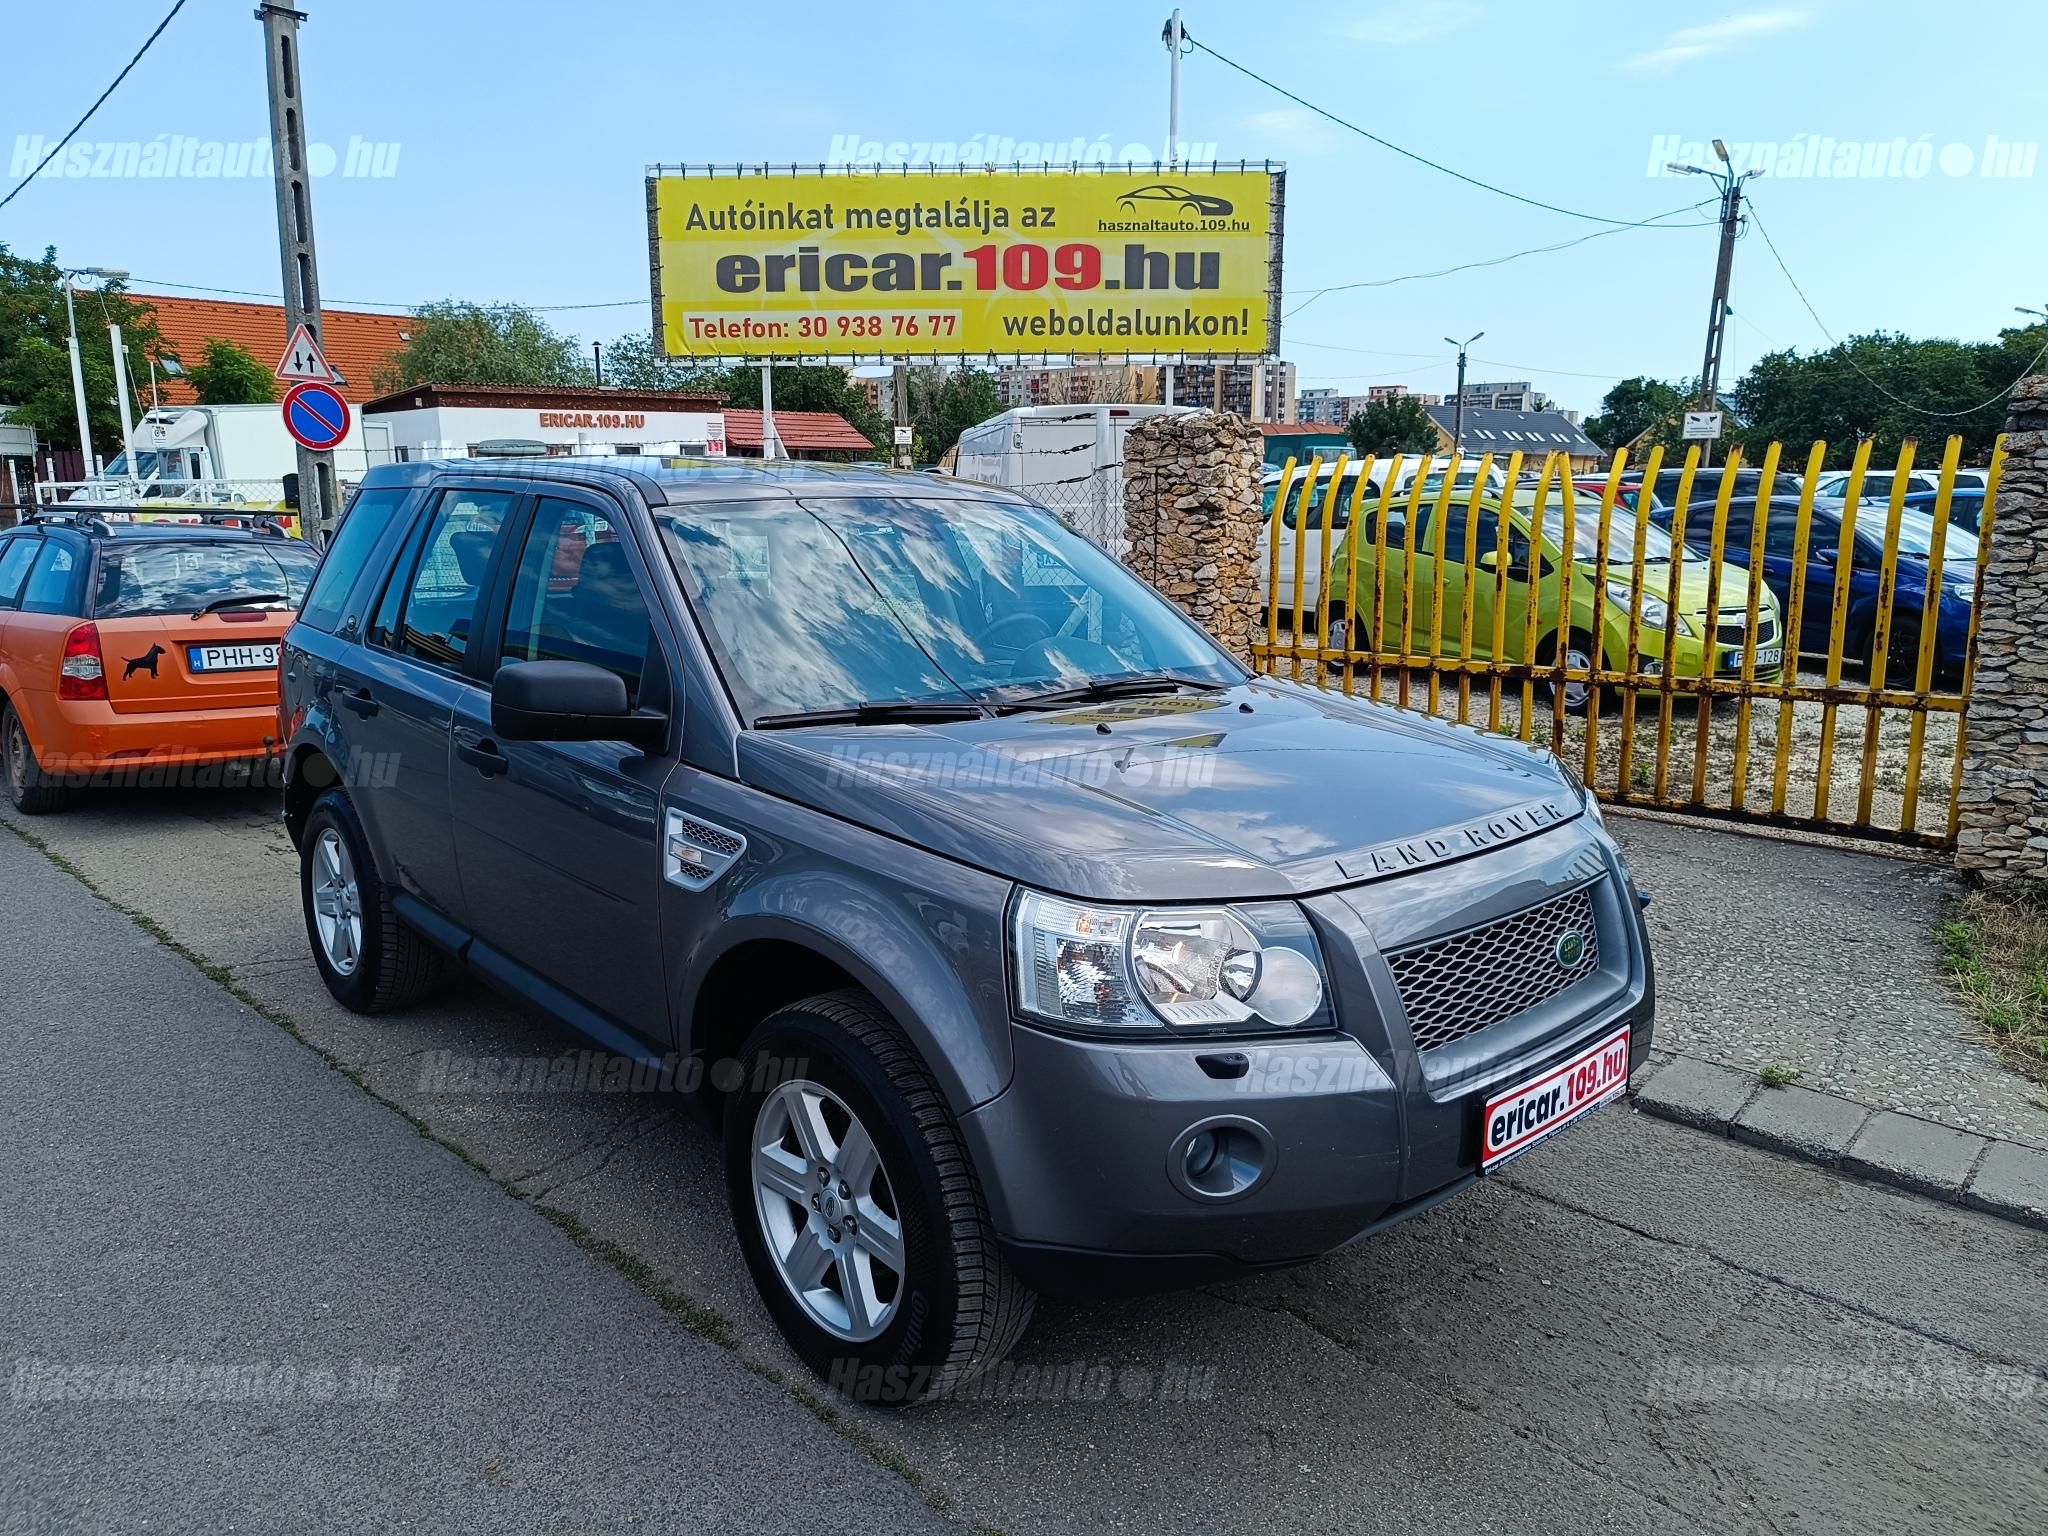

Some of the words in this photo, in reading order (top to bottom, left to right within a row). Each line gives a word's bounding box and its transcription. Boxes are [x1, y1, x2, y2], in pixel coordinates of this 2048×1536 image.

[686, 199, 834, 231] Autóinkat
[846, 196, 1009, 235] megtalálja
[1021, 206, 1056, 228] az
[1098, 219, 1250, 232] hasznaltauto.109.hu
[716, 243, 1220, 293] ericar.109.hu
[689, 317, 789, 339] Telefon:
[798, 316, 828, 337] 30
[837, 316, 882, 337] 938
[891, 315, 919, 337] 76
[928, 315, 956, 336] 77
[1003, 308, 1249, 337] weboldalunkon!
[539, 413, 645, 428] ERICAR.109.HU
[1736, 649, 1779, 665] P-128
[1334, 839, 1452, 880] LAND
[1463, 803, 1565, 848] ROVER
[1491, 1047, 1624, 1147] ericar.109.hu
